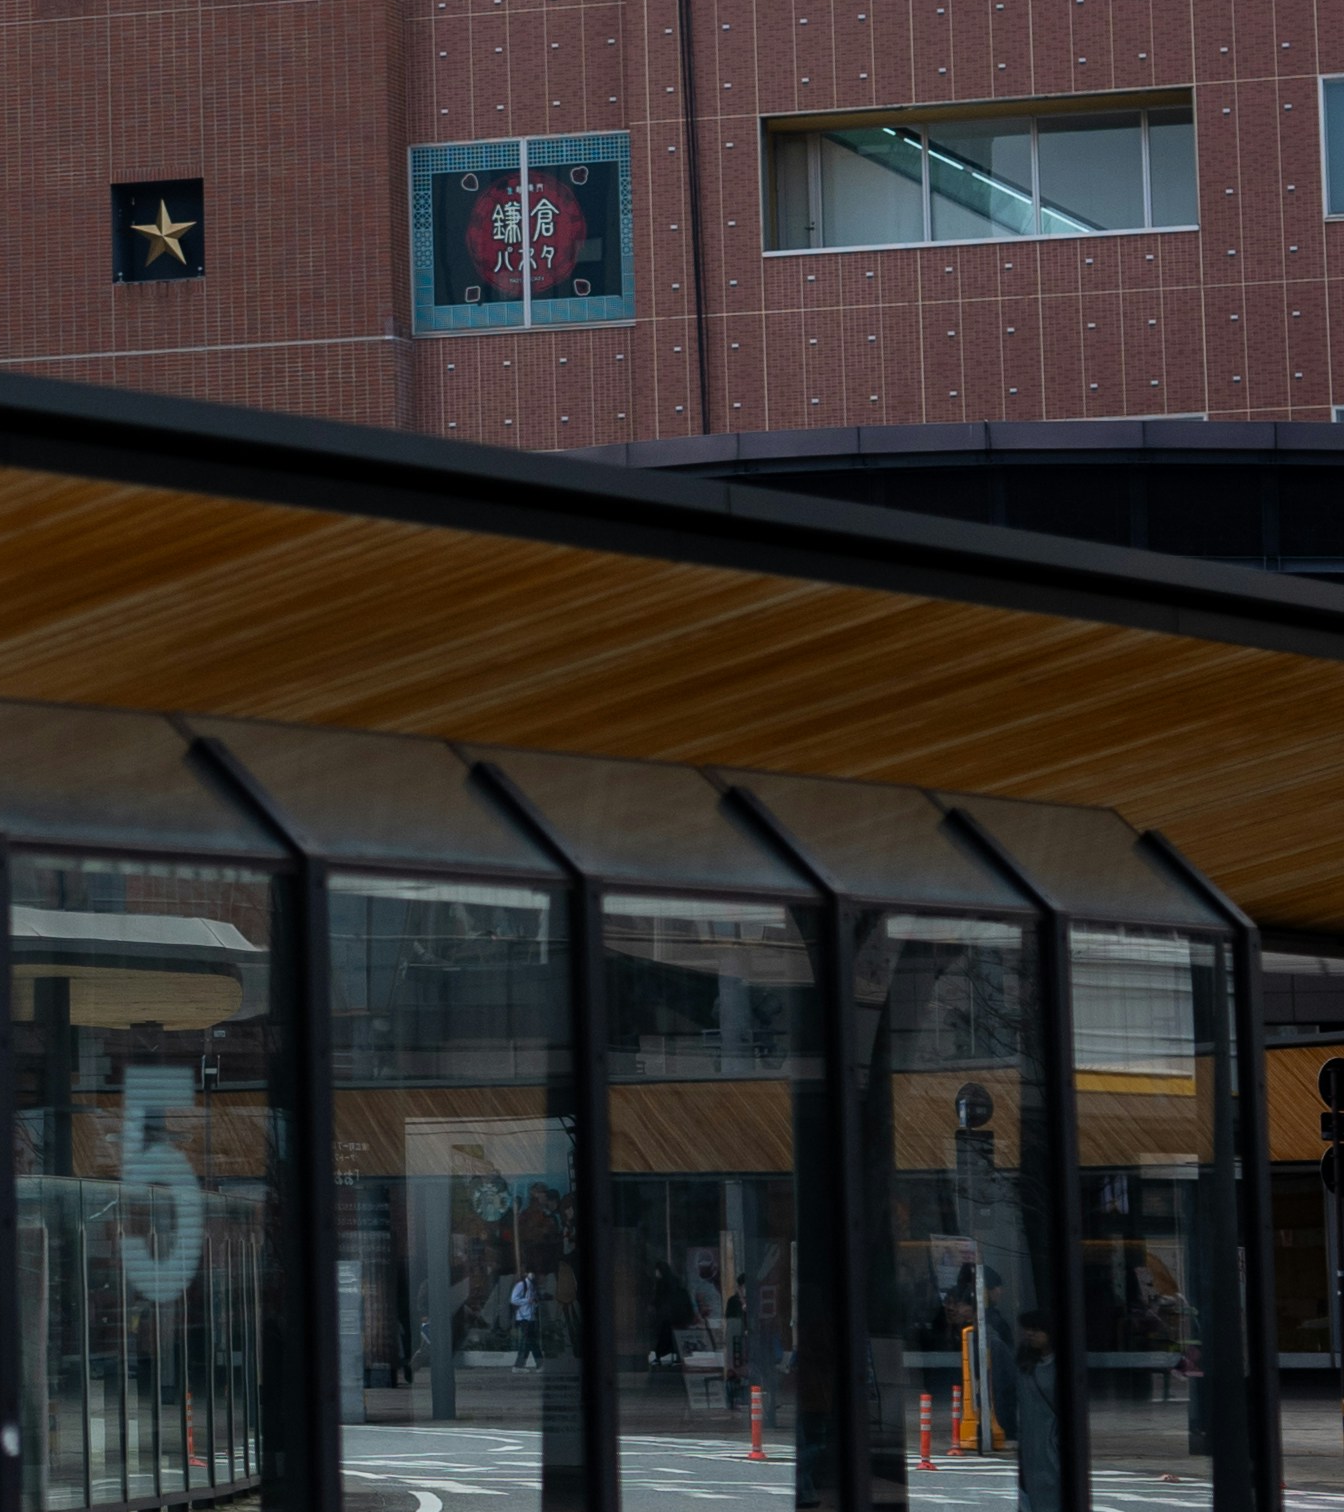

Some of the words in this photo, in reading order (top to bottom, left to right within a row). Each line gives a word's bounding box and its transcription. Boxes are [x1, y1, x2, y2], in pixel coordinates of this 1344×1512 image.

[492, 198, 560, 244] 鎌倉
[494, 245, 555, 273] パスタ
[122, 1065, 203, 1302] 5
